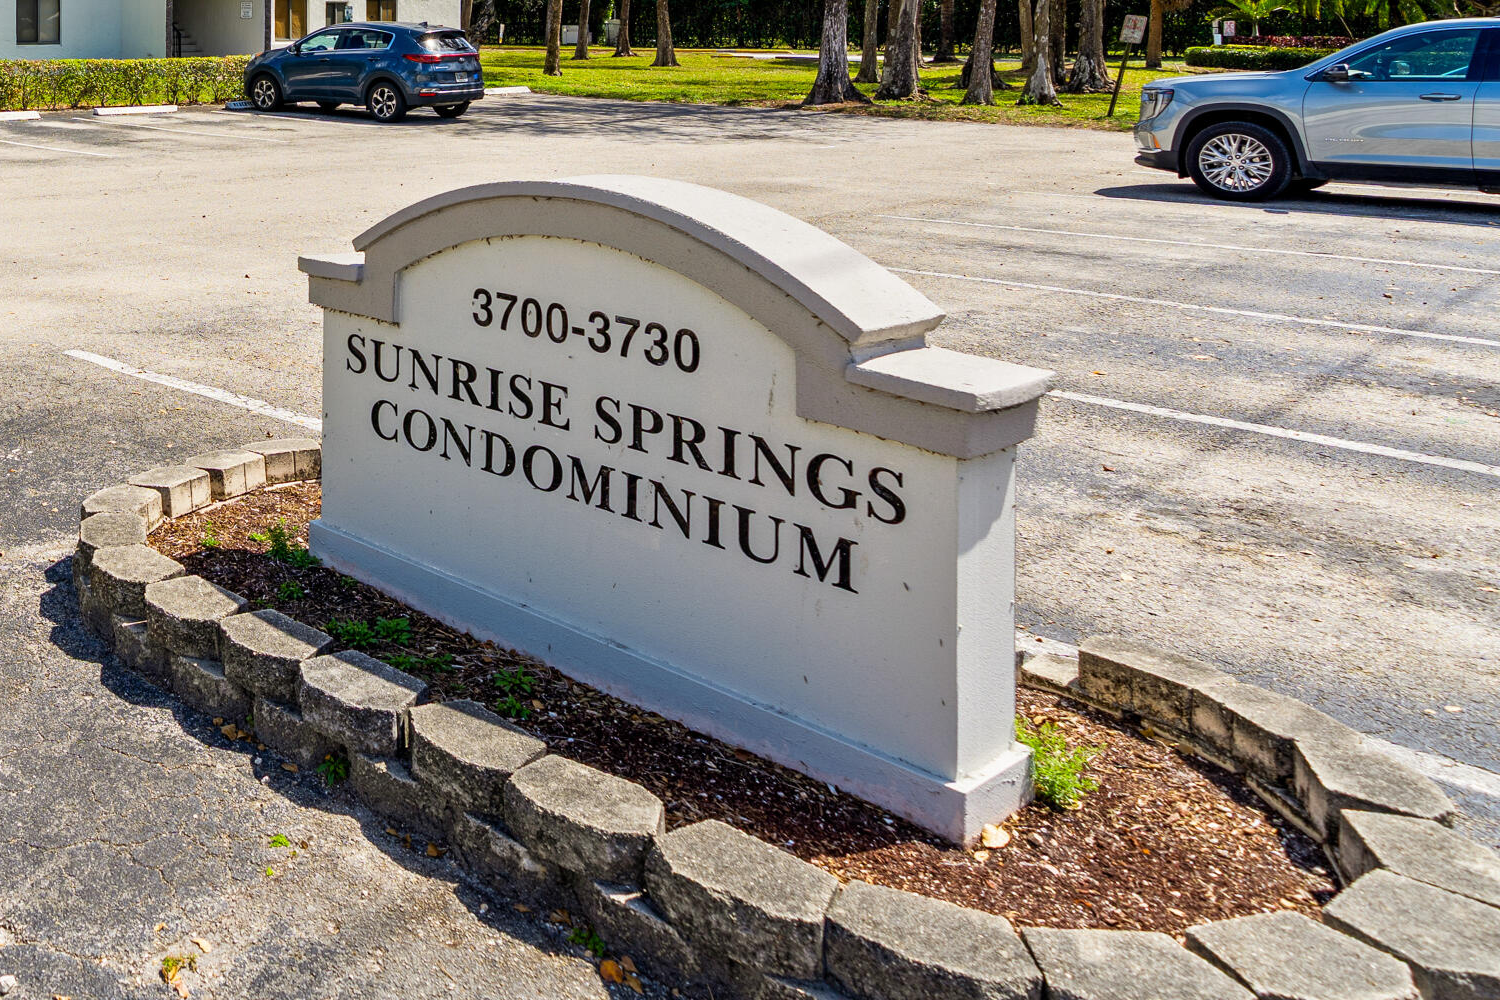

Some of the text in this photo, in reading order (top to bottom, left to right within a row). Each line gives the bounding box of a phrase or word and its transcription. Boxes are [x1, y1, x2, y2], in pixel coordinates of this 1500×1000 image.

[471, 287, 701, 373] 3700-3730
[345, 333, 907, 525] SUNRISE SPRINGS
[370, 399, 859, 595] CONDOMINIUM
